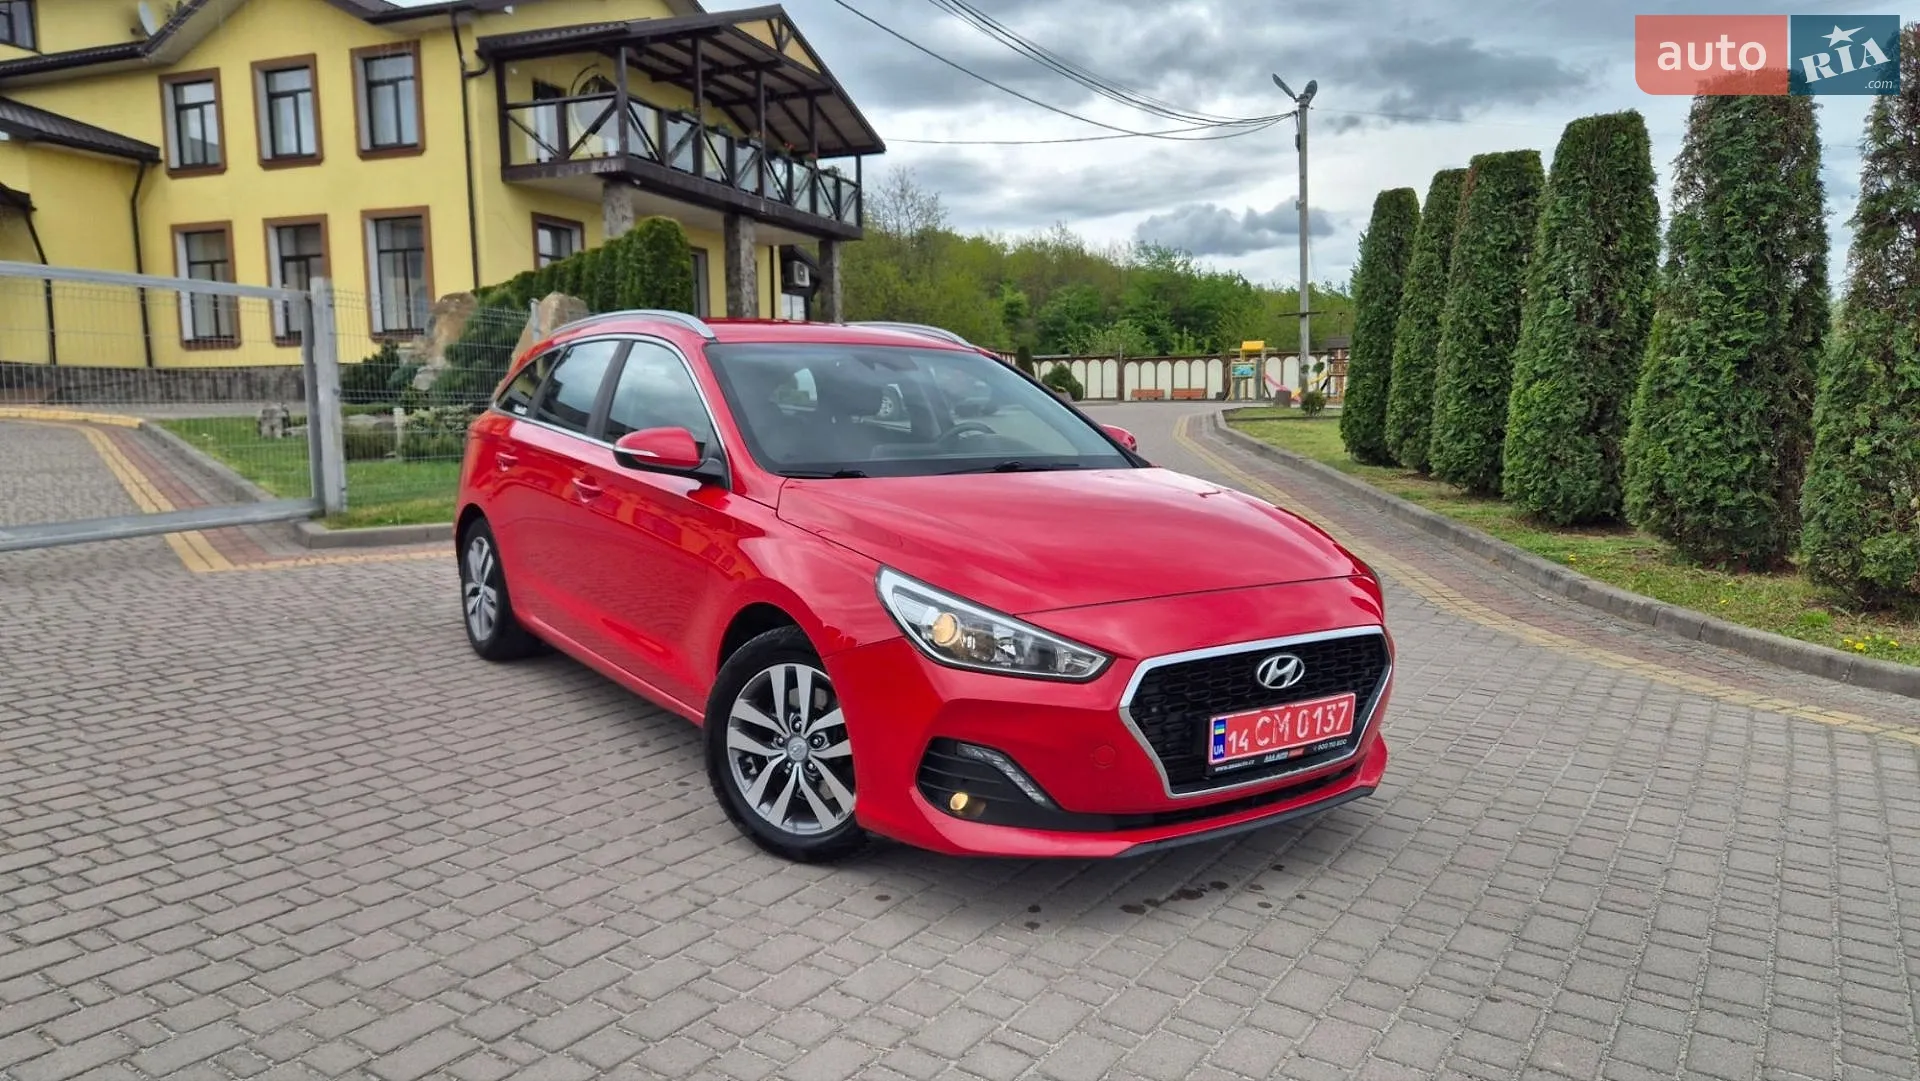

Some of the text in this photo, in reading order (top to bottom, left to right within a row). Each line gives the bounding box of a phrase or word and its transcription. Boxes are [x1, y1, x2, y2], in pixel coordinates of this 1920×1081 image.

[1228, 728, 1249, 754] 14
[1255, 711, 1291, 747] CM
[1213, 744, 1224, 755] UA
